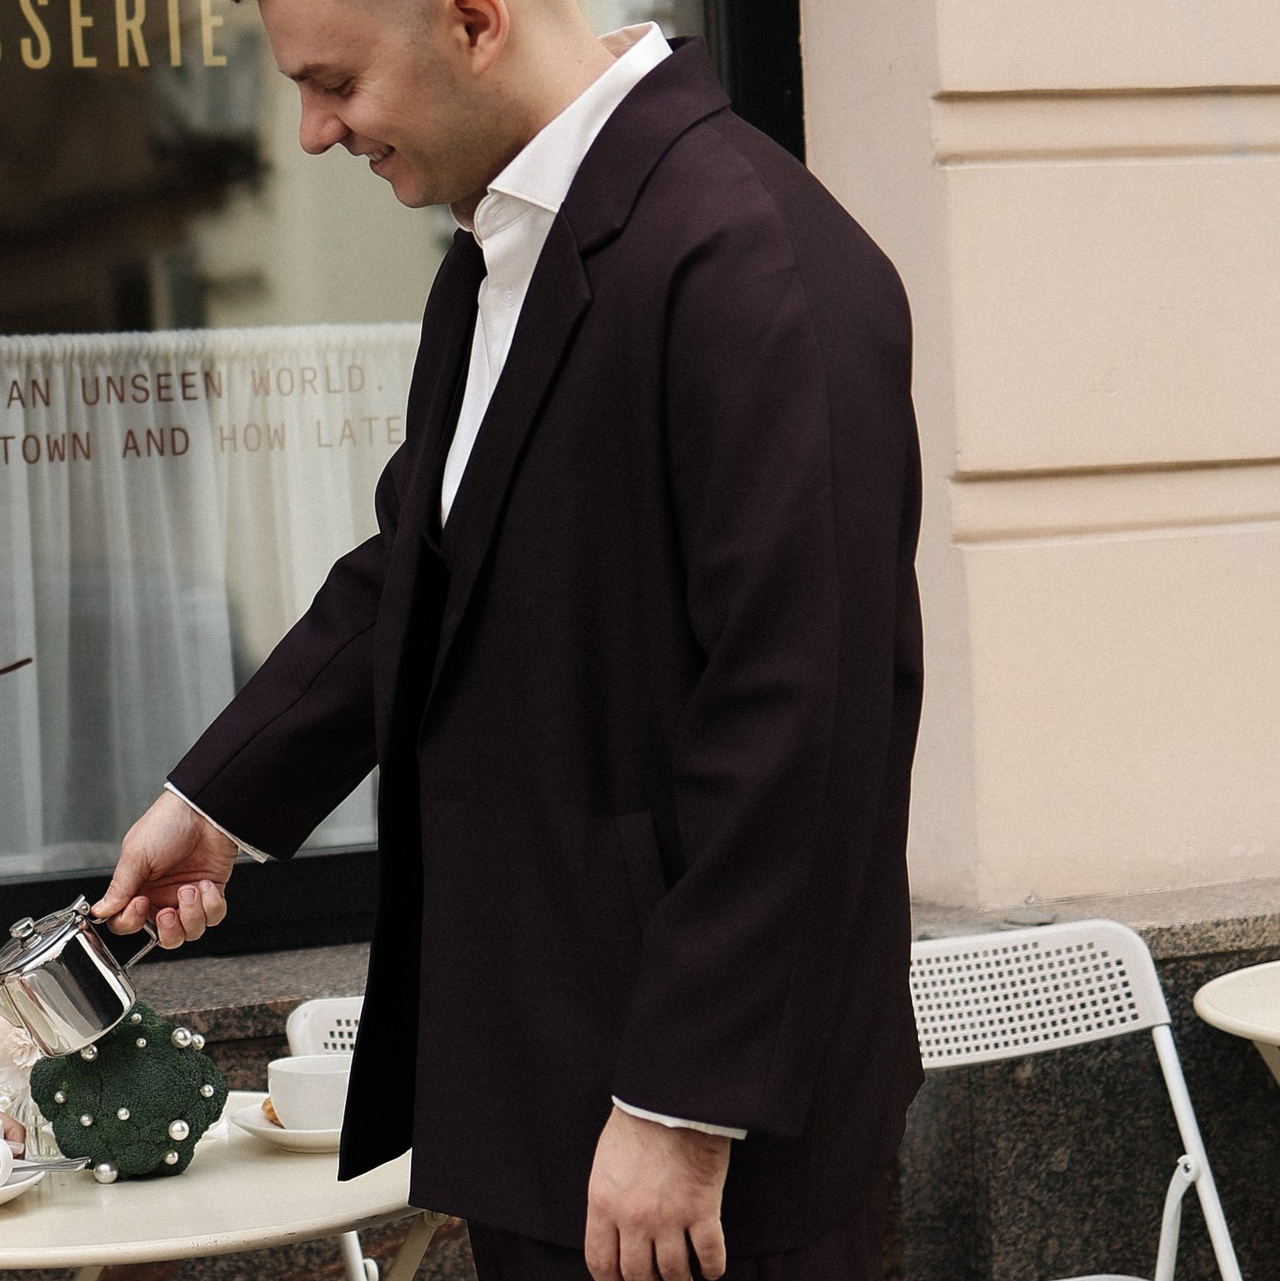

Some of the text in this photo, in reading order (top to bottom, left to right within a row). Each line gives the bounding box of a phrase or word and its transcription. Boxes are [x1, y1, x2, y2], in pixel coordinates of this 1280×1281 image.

[6, 378, 52, 410] AN
[81, 370, 223, 407] UNSEEN
[252, 363, 385, 398] WORLD.
[122, 426, 190, 460] AND
[219, 421, 287, 454] HOW
